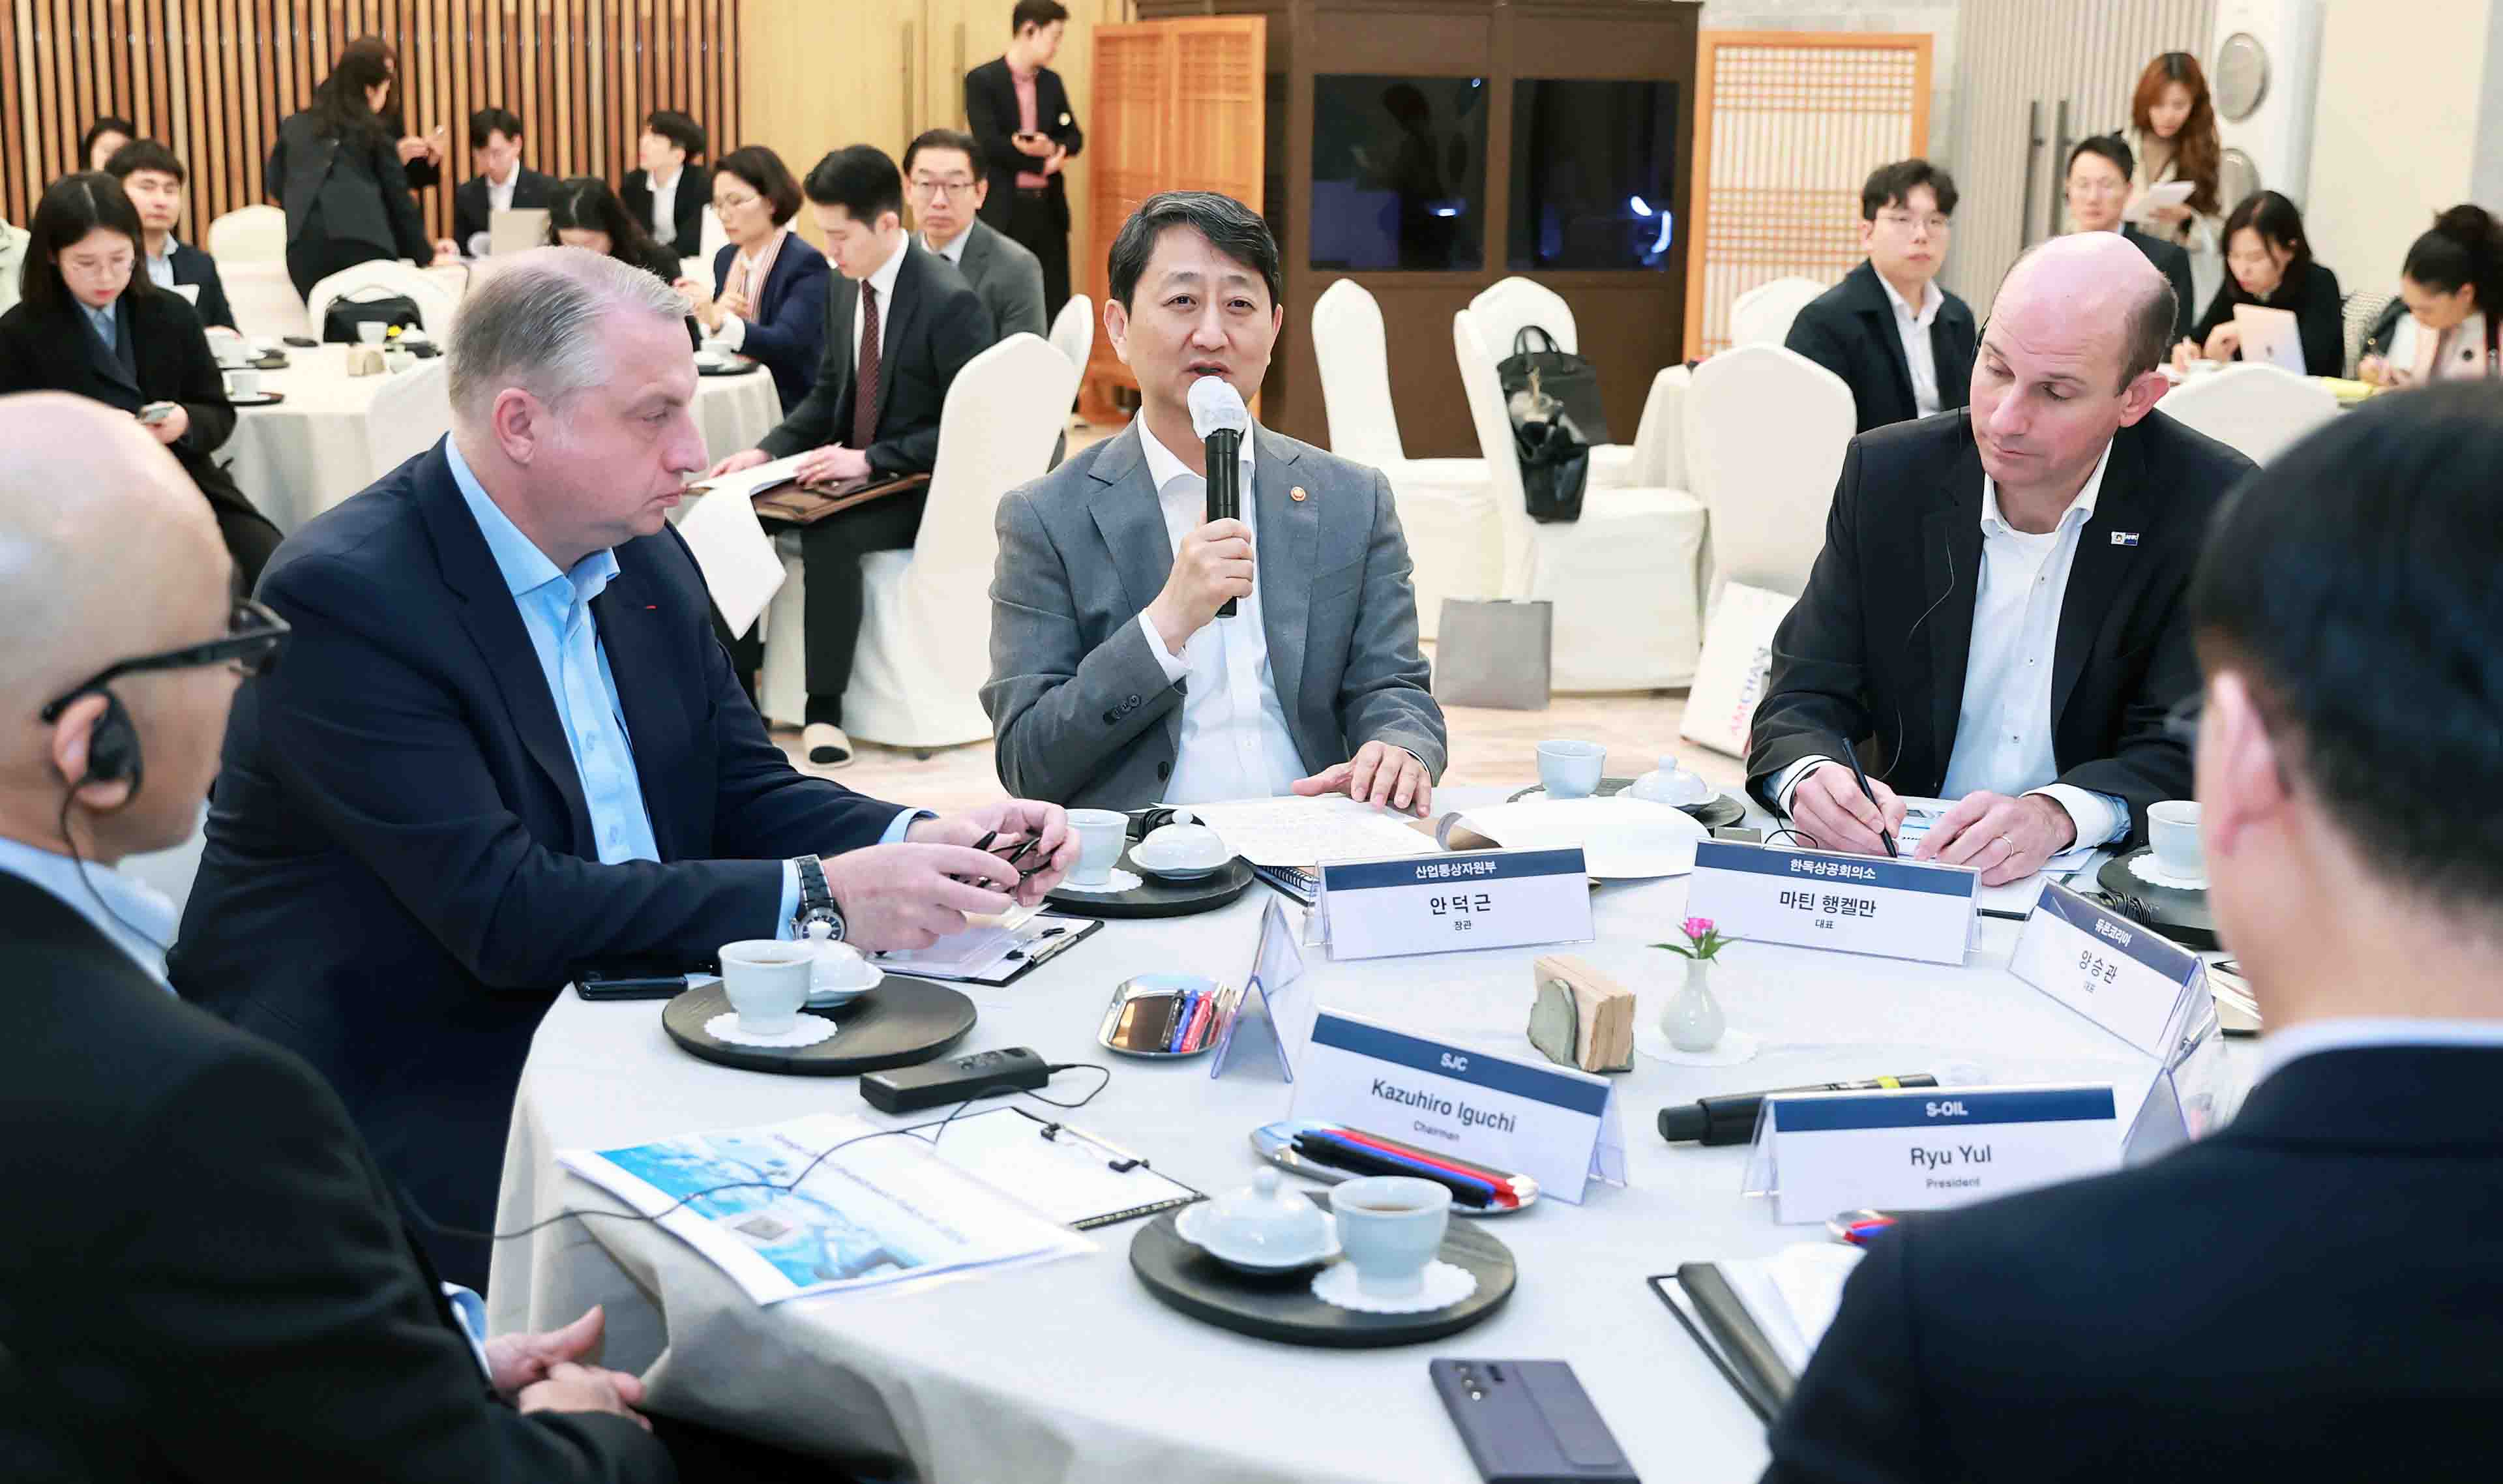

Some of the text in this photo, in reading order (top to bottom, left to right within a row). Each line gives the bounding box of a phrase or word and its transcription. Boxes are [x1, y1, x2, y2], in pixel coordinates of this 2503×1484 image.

[1415, 860, 1498, 879] 산업통상자원부
[1790, 858, 1876, 880] 한독상공회의소
[1779, 891, 1876, 918] 마틴 행켈만
[1455, 920, 1472, 931] 장관
[1814, 919, 1835, 929] 대표
[1440, 1052, 1468, 1072] SJC
[1371, 1077, 1517, 1133] Kazuhiro Iguchi
[1925, 1101, 1968, 1118] S-OIL
[1413, 1120, 1460, 1142] Chairman
[1910, 1144, 1992, 1170] Ryu Yul
[1925, 1176, 1980, 1189] President
